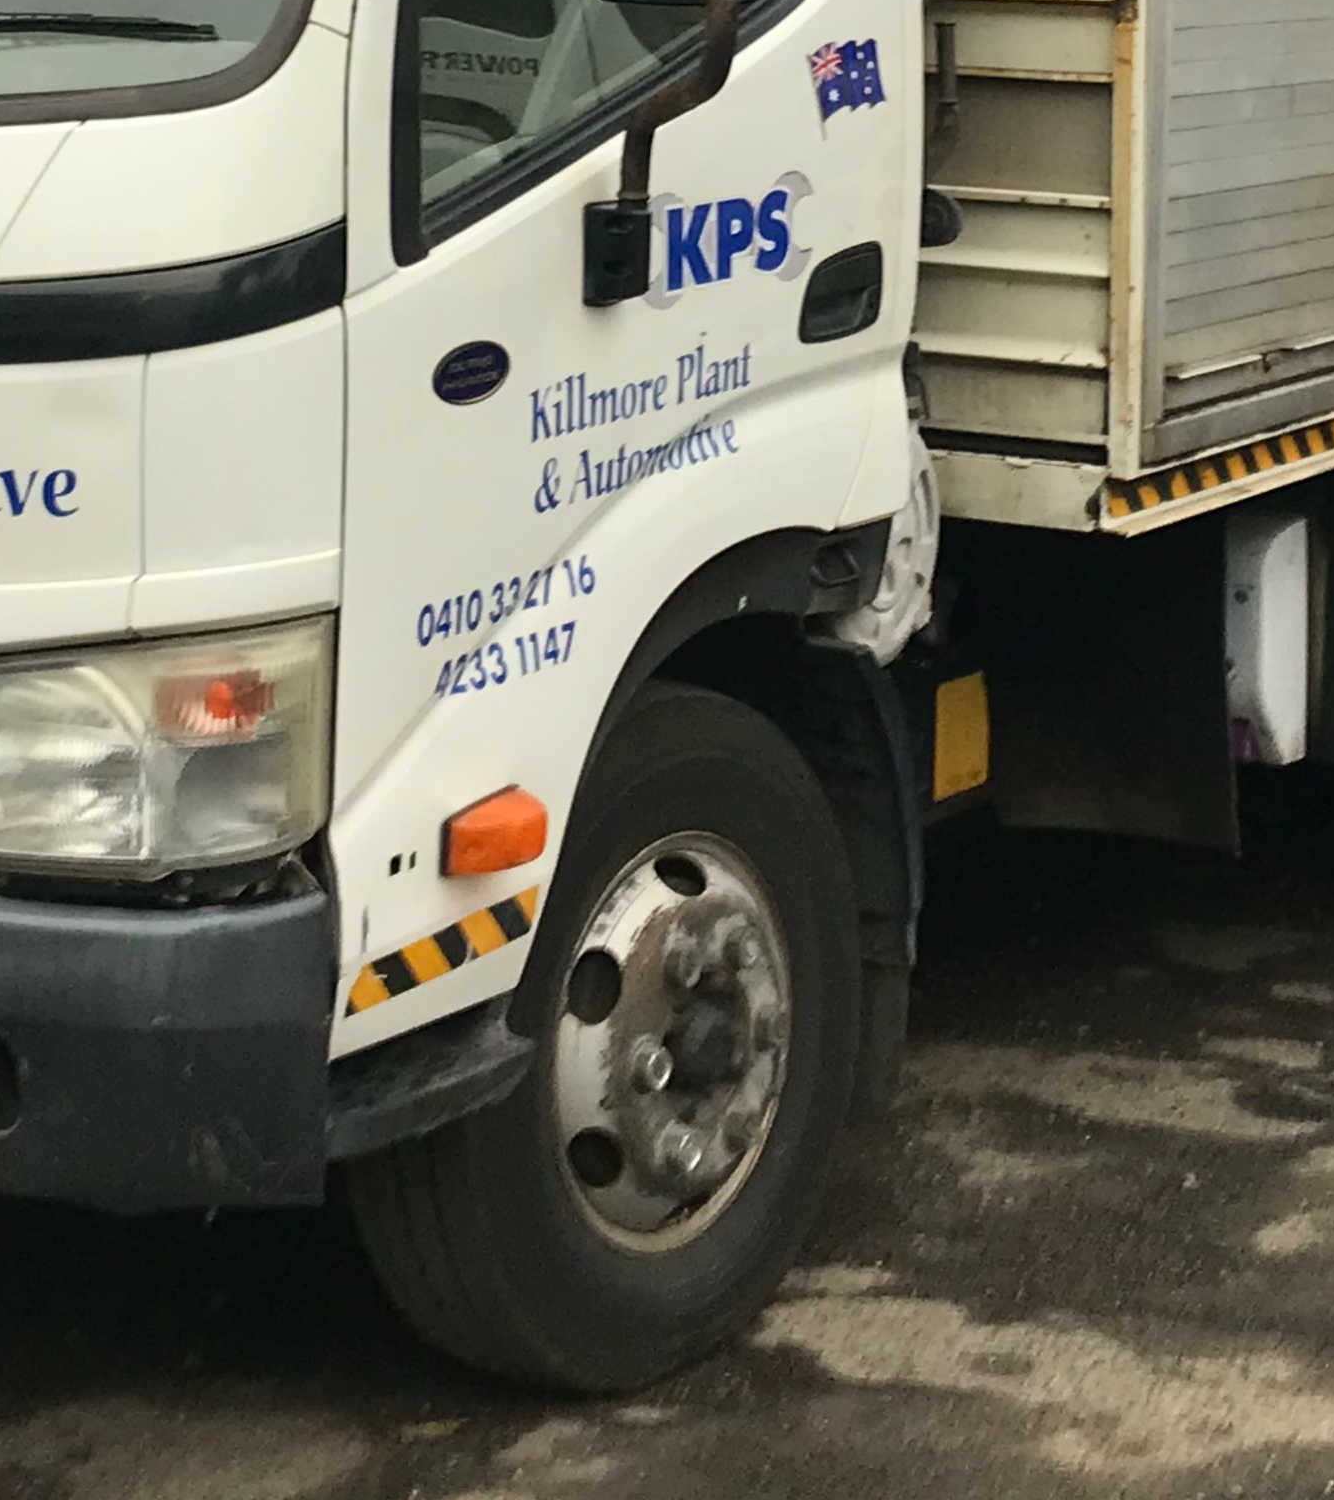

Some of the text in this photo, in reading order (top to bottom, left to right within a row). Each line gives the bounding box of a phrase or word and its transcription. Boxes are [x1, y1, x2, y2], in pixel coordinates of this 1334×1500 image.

[666, 189, 791, 294] KPS
[529, 342, 752, 443] Killmore Plant
[533, 412, 740, 514] & Automotive
[417, 588, 483, 647] 0410
[434, 619, 577, 699] 4233 1147
